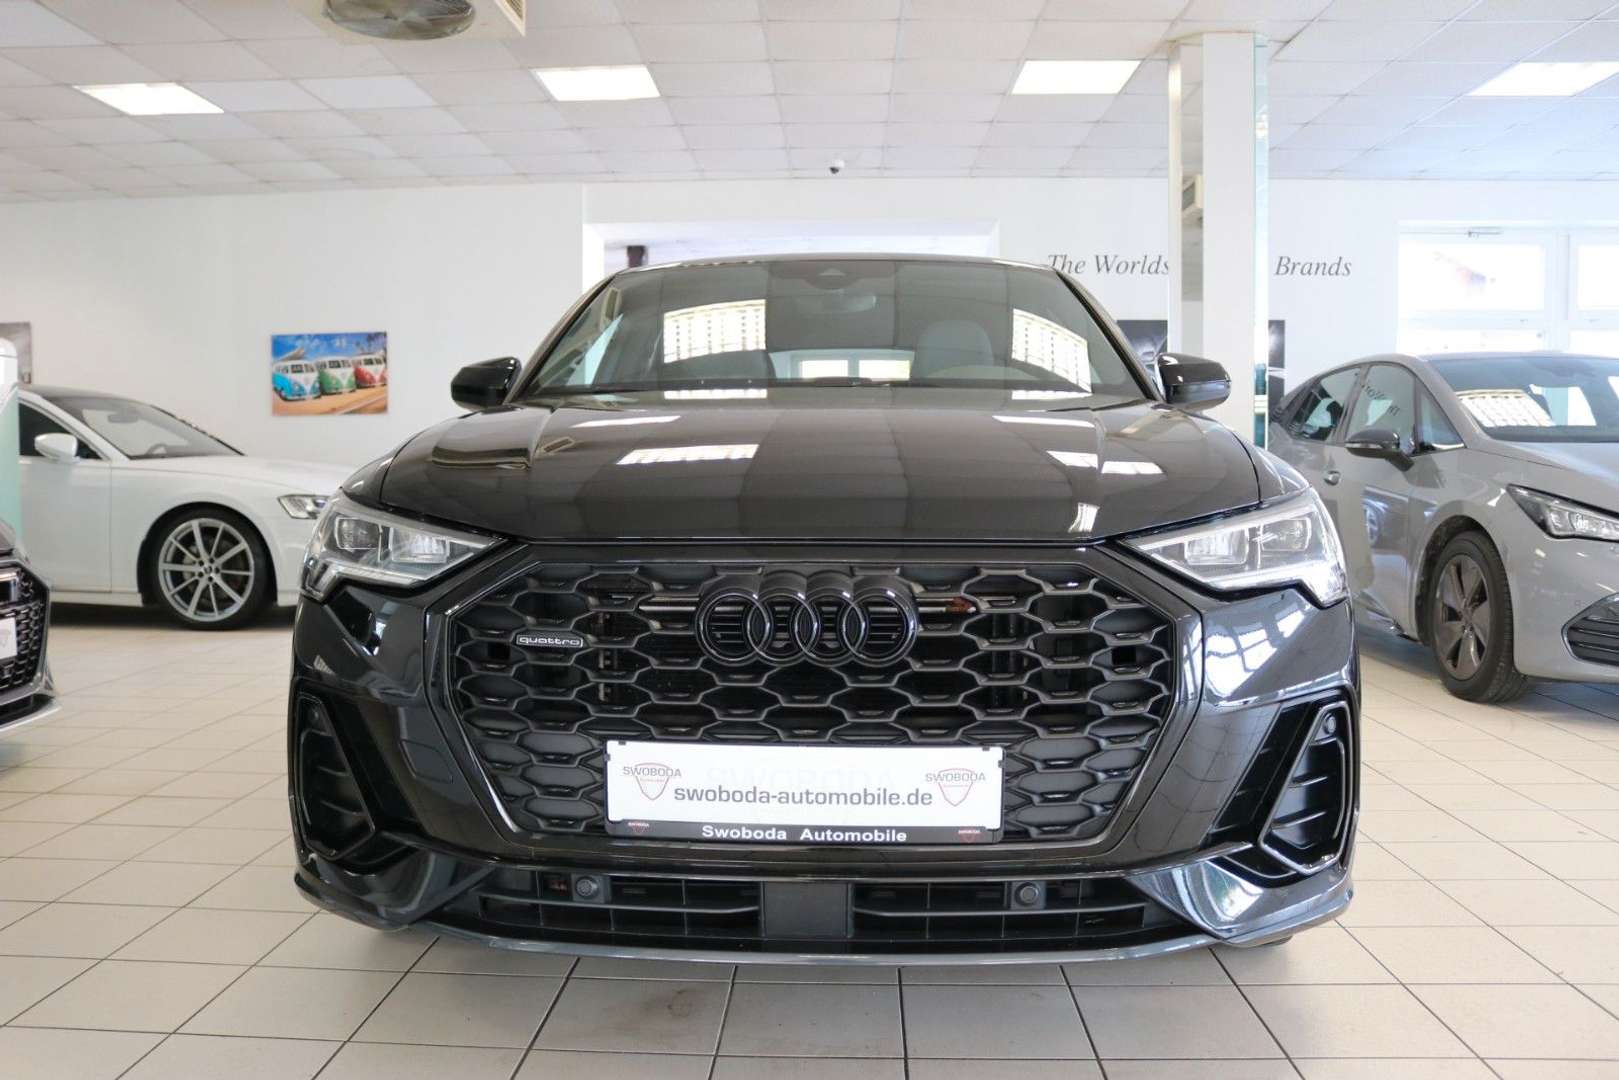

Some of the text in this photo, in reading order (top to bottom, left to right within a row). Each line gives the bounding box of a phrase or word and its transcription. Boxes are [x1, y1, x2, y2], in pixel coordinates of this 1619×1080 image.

[1048, 254, 1352, 276] The Worlds Brands
[519, 637, 580, 645] quattro
[623, 766, 682, 778] SWOBODA
[925, 772, 986, 783] SWOBODA
[674, 785, 933, 806] swoboda-automobile.de
[702, 825, 907, 842] Swoboda Automobile
